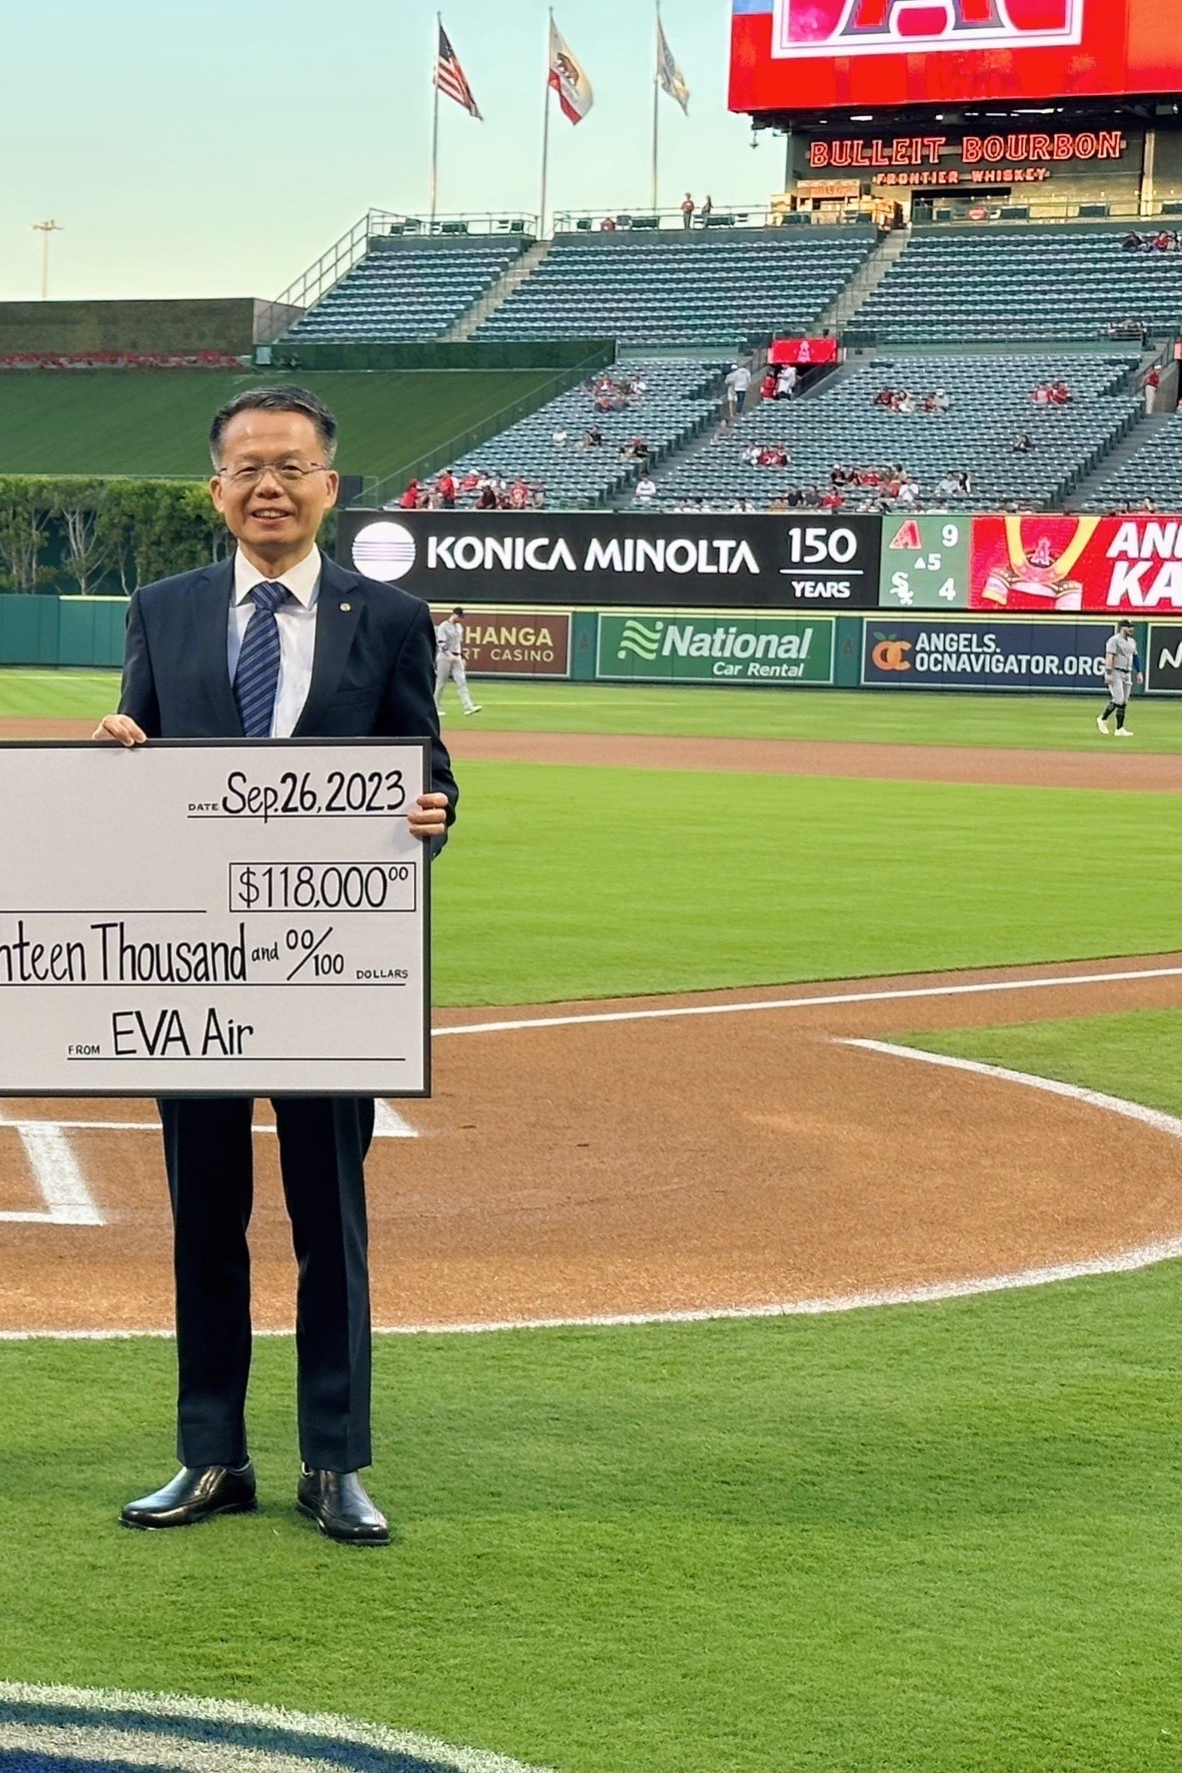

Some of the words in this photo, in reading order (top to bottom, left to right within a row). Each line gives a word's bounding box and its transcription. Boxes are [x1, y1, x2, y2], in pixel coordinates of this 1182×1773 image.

[809, 137, 946, 168] BULLEIT
[962, 131, 1122, 163] BOURBON
[874, 171, 959, 185] FRONTIER
[971, 168, 1049, 183] WHISKEY
[788, 527, 857, 563] 150
[941, 524, 959, 547] 9
[428, 536, 576, 571] KONICA
[583, 538, 760, 574] MINOLTA
[791, 581, 851, 598] YEARS
[938, 578, 956, 601] 4
[662, 624, 813, 660] National
[915, 632, 1001, 653] ANGELS.
[490, 648, 555, 663] CASINO
[915, 652, 1106, 676] OCNAVIGATOR.ORG
[713, 661, 742, 677] Car
[747, 662, 804, 678] Rental
[188, 803, 219, 811] DATE
[90, 921, 247, 982] Thousand
[251, 942, 279, 961] and
[356, 969, 408, 979] DOLLARS
[112, 1009, 191, 1056] EVA
[201, 1007, 254, 1056] Air
[68, 1044, 100, 1055] FROM
